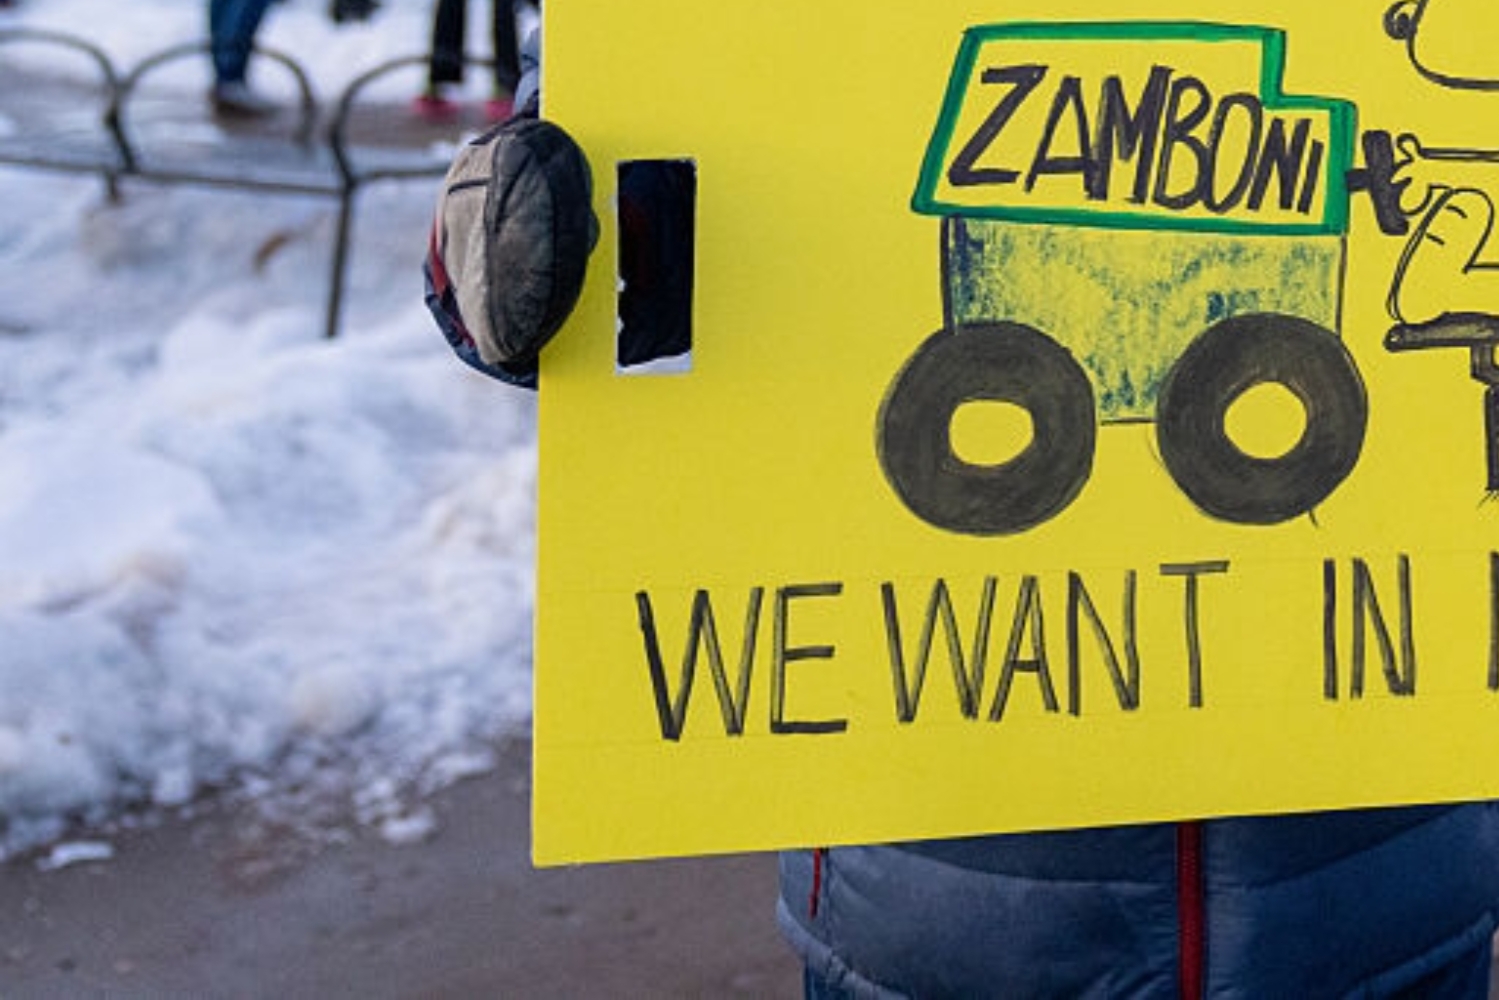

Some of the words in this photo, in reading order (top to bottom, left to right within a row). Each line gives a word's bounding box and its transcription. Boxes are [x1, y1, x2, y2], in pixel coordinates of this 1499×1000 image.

[947, 63, 1325, 215] ZAMBONI
[635, 581, 848, 742] WE
[881, 559, 1231, 724] WANT
[1322, 552, 1416, 701] IN
